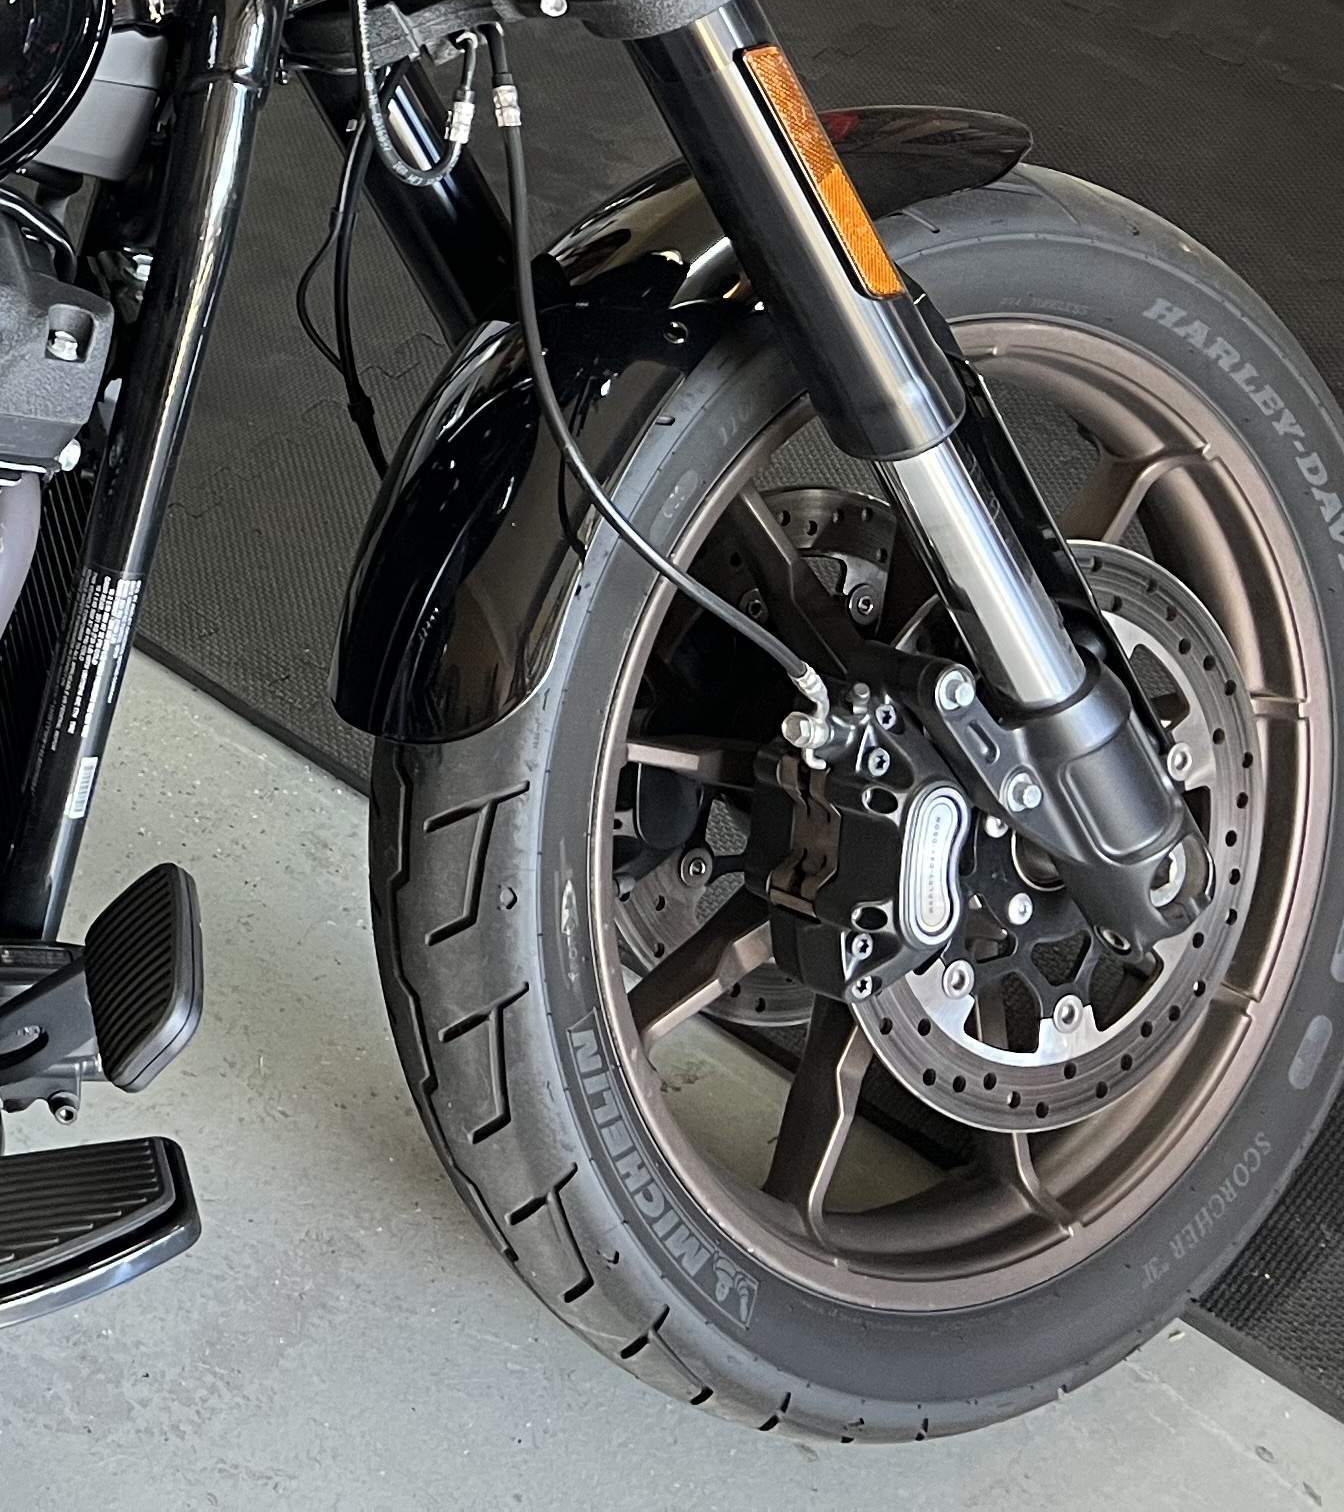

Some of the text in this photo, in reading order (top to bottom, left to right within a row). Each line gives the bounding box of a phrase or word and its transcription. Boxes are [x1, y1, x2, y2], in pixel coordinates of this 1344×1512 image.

[1141, 297, 1344, 570] HARLEY-DAV
[571, 1029, 711, 1278] MICHELIN
[1168, 1131, 1273, 1260] SCORCHER
